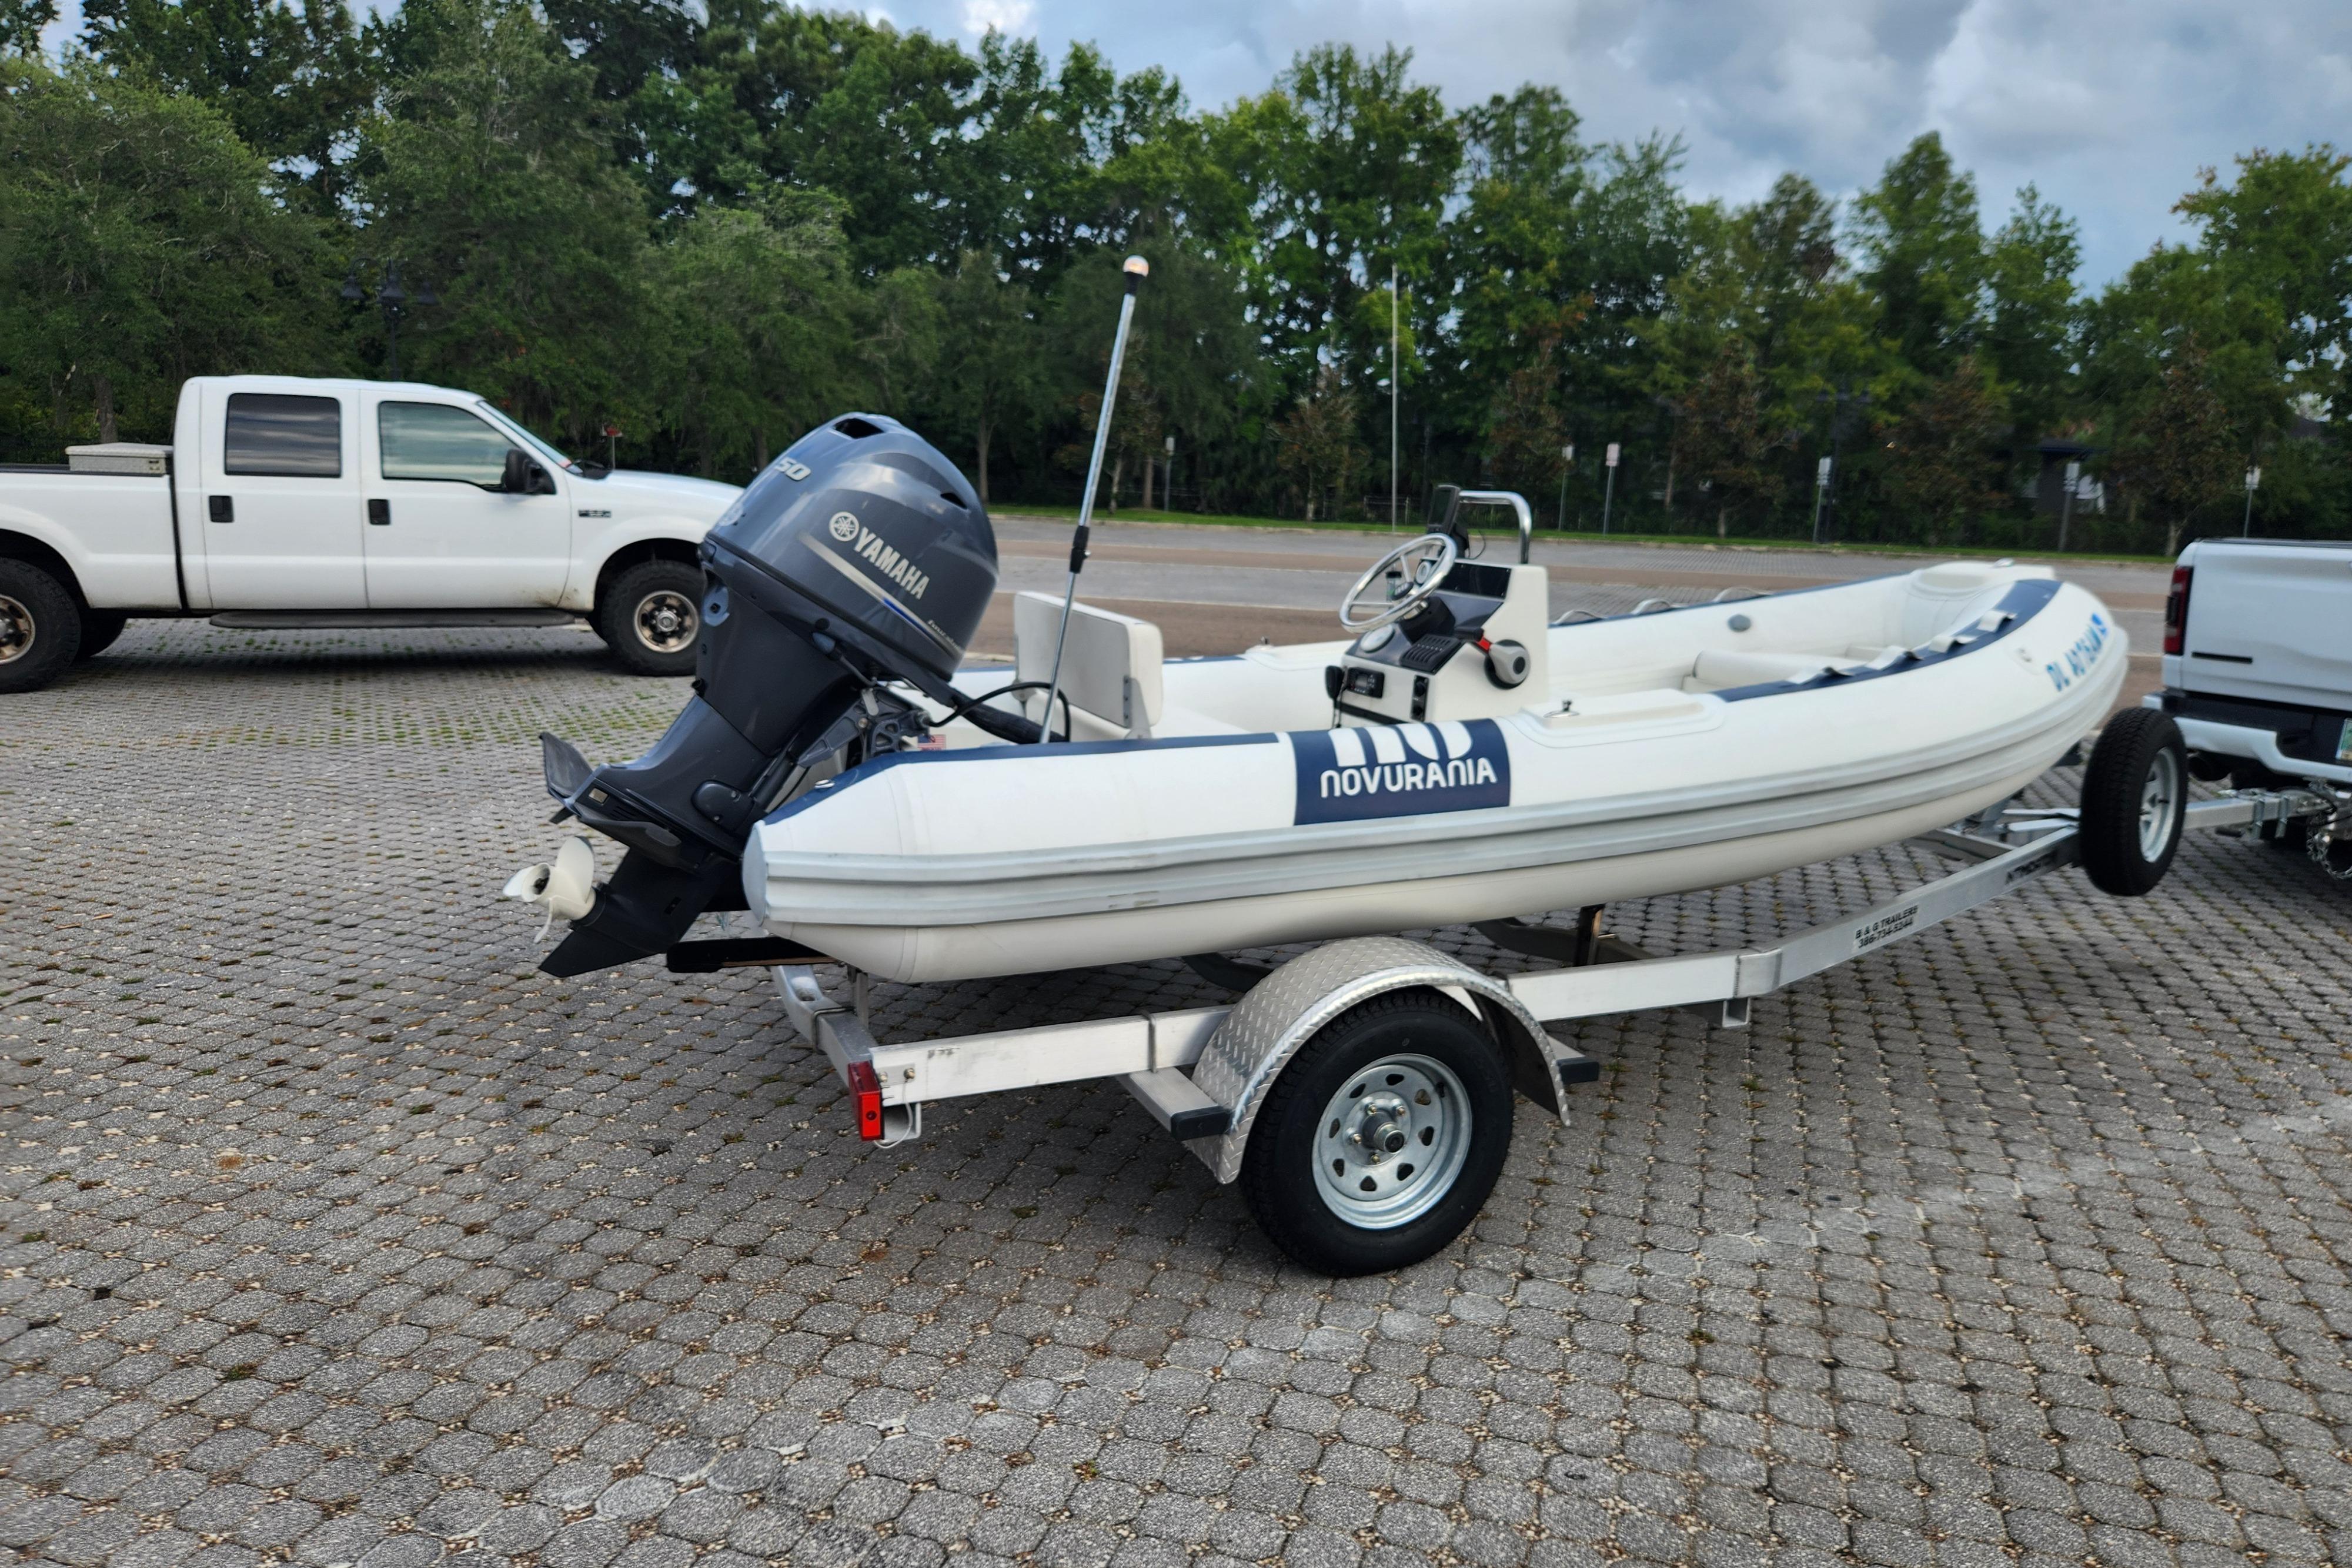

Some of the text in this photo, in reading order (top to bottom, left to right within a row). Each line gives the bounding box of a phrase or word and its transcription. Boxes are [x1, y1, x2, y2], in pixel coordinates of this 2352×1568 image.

[774, 457, 811, 480] 50
[854, 527, 930, 600] YAMAHA
[1321, 757, 1498, 798] NOVURANIA
[1881, 905, 1918, 927] TRAILERS
